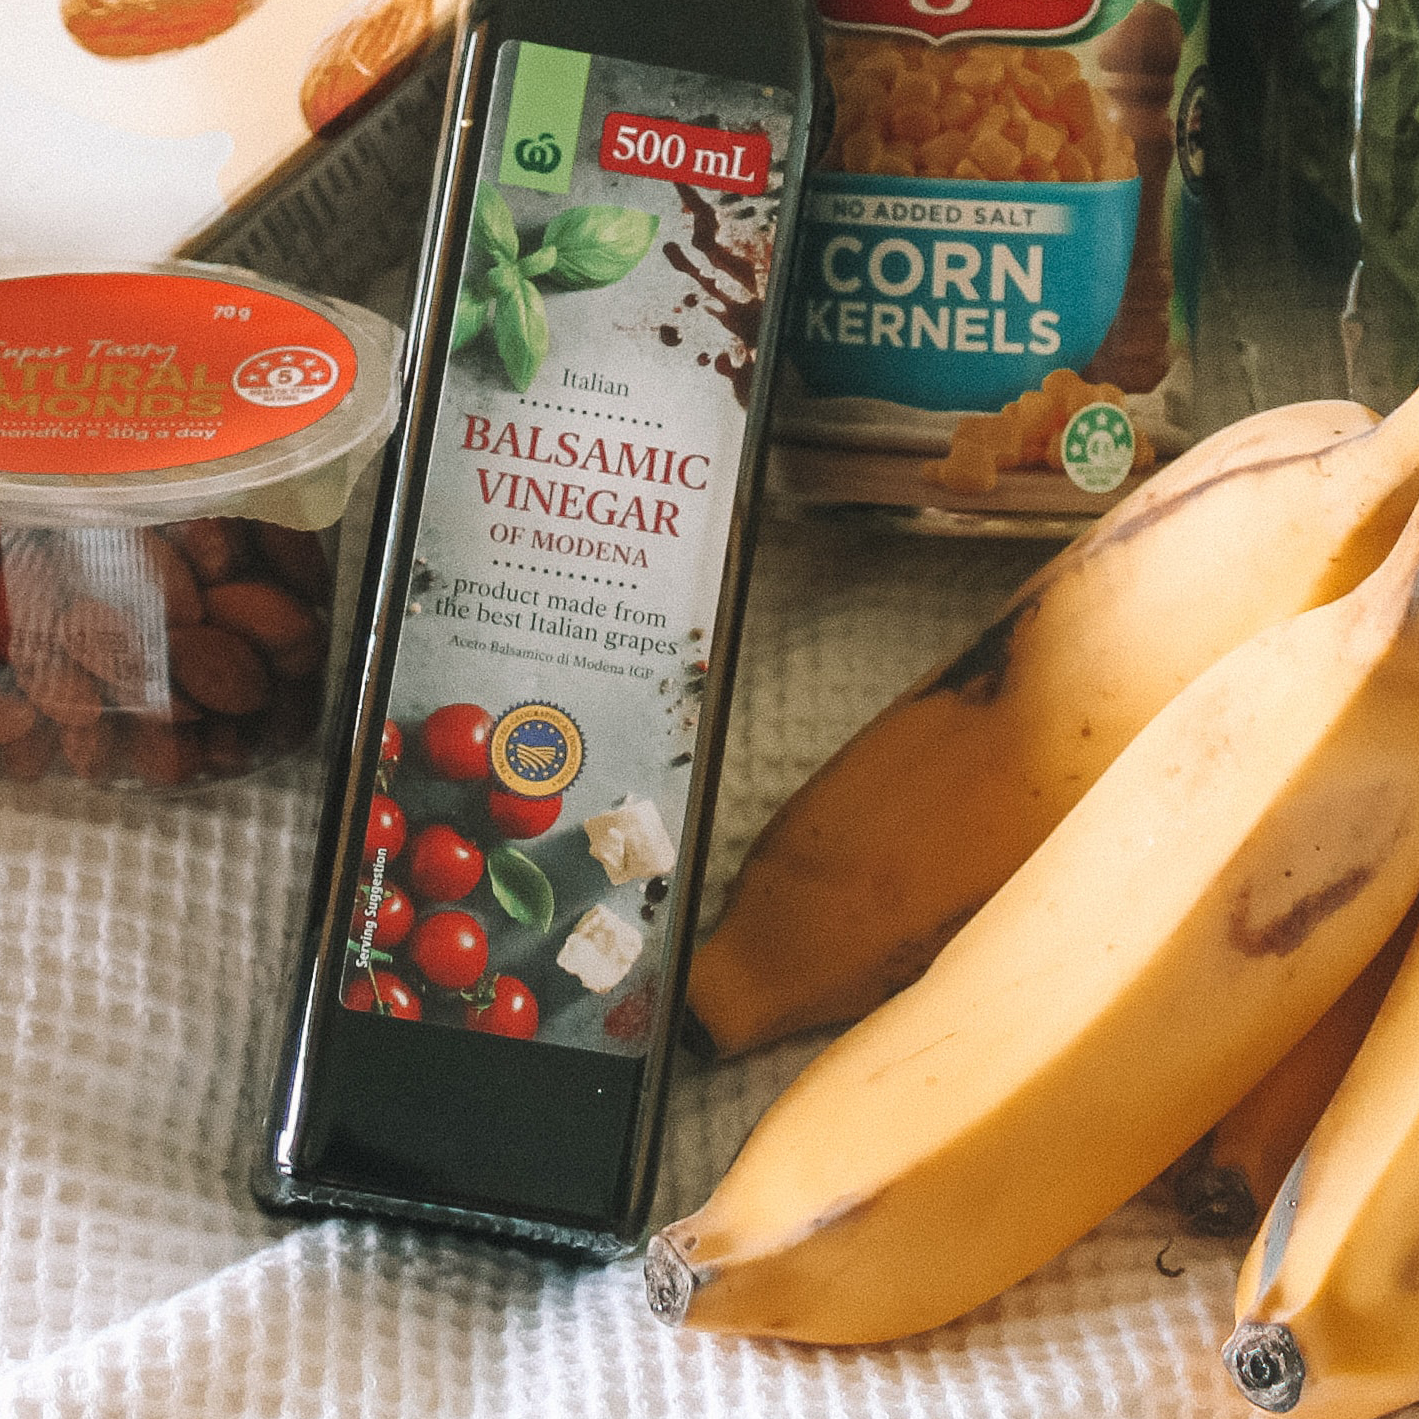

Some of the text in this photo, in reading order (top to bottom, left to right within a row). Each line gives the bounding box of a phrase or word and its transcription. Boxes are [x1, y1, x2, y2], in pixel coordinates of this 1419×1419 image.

[613, 124, 756, 183] 500 mL
[833, 198, 1037, 228] NO ADDED SALT
[822, 236, 1045, 304] CORN
[805, 297, 1063, 356] KERNELS
[561, 367, 630, 398] Italian
[460, 413, 712, 491] BALSAMIC
[476, 467, 681, 538] VINEGAR
[489, 522, 650, 569] OF MODENA
[435, 595, 679, 656] the best Italian grapes
[453, 578, 667, 629] product made from
[449, 634, 487, 651] Aceto
[490, 640, 554, 664] Balsamico
[557, 652, 570, 667] di
[573, 655, 624, 676] Modena
[355, 847, 388, 969] Serving Suggestion
